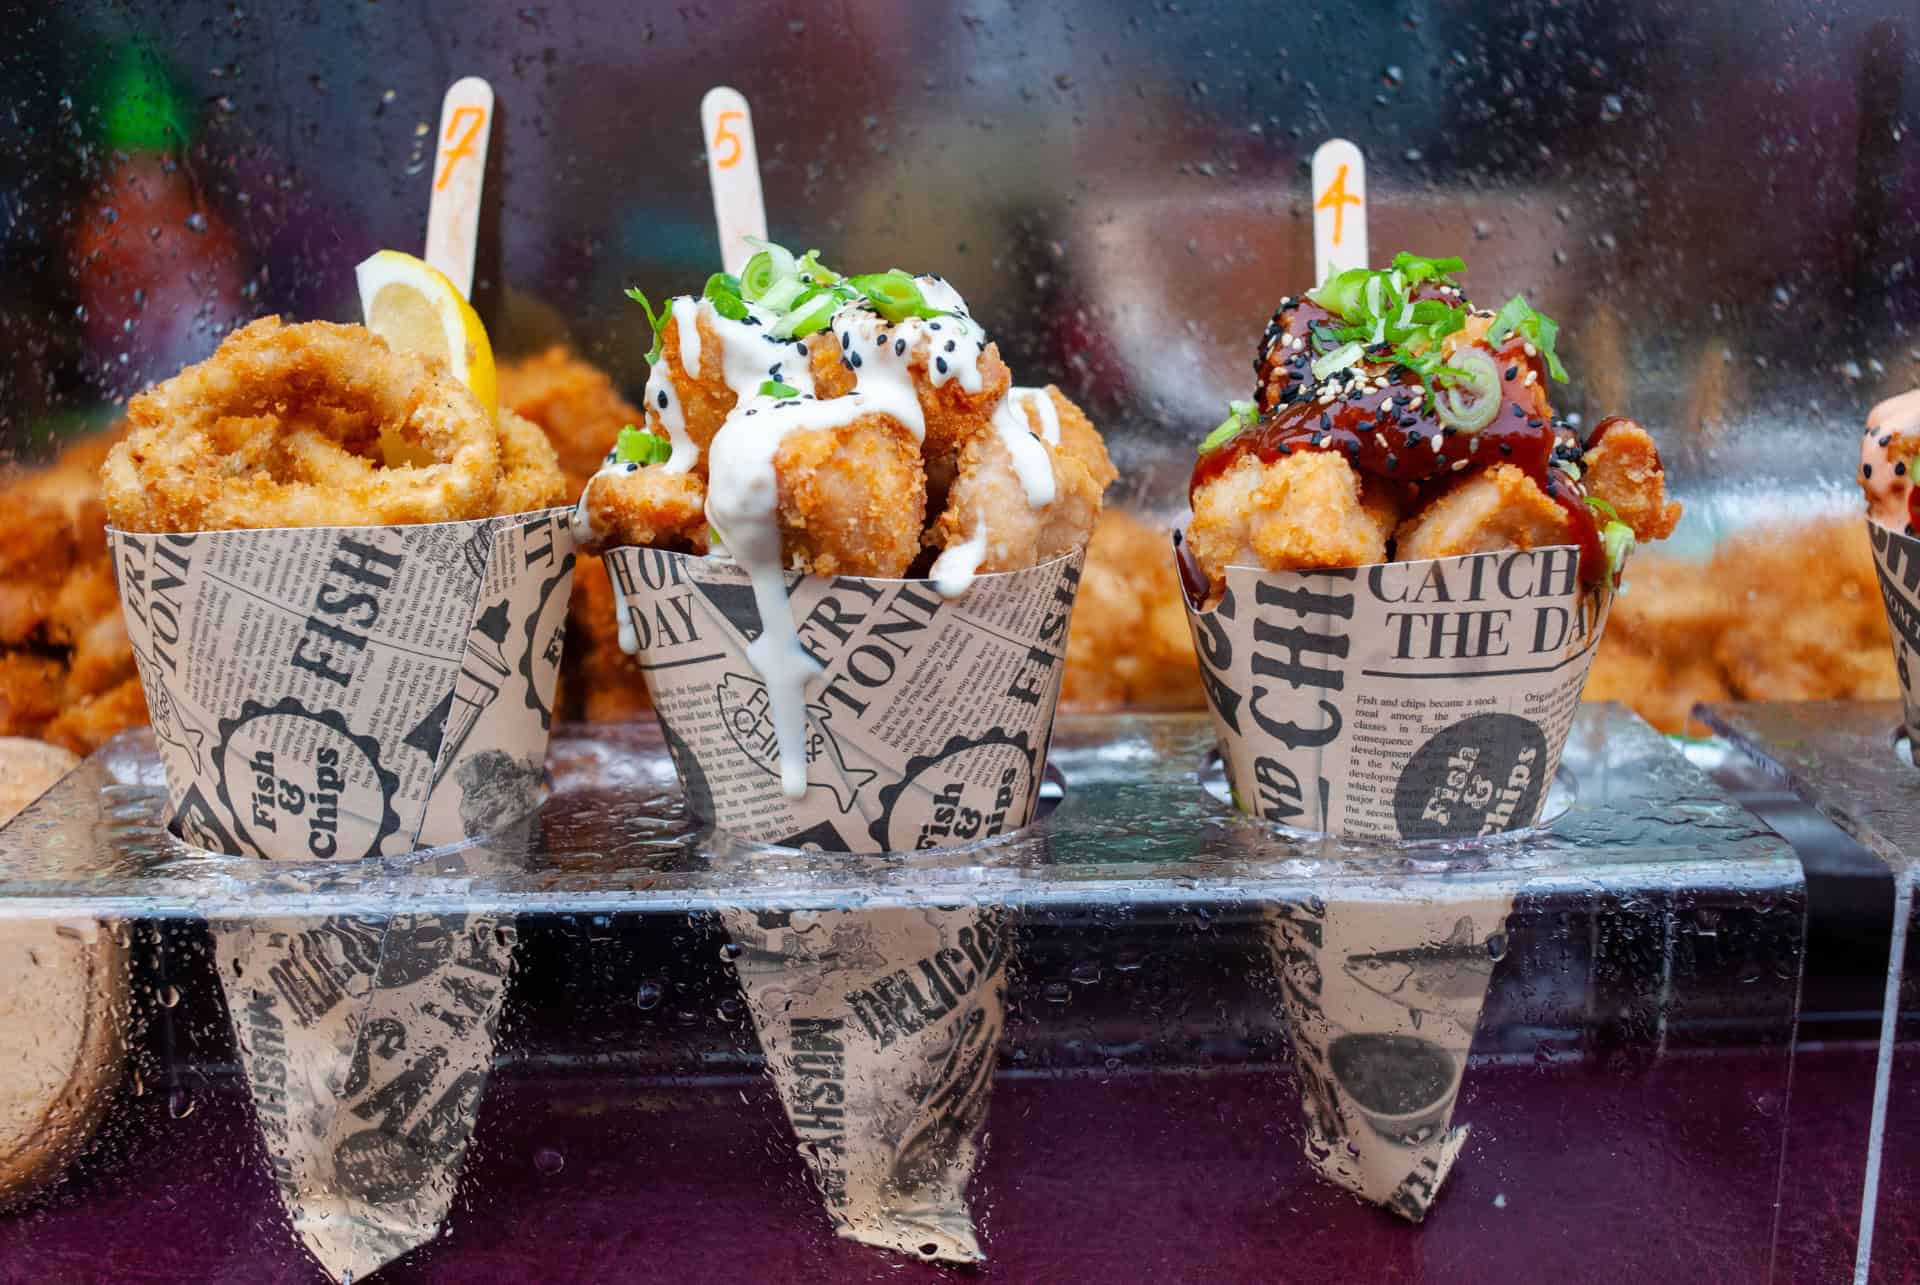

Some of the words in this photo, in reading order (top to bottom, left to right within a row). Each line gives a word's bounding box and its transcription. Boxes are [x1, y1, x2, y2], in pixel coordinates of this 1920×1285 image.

[437, 107, 486, 190] 7
[714, 111, 745, 168] 5
[1315, 163, 1362, 245] 4
[1368, 548, 1580, 603] CATCH
[291, 536, 402, 688] FISH
[628, 593, 702, 650] DAY
[797, 577, 886, 670] FRY
[1385, 609, 1512, 660] THE
[818, 581, 944, 719] TONI
[1250, 568, 1357, 750] CHI
[1353, 720, 1386, 731] classes
[1400, 725, 1408, 733] in
[1356, 709, 1378, 718] meal
[1391, 713, 1424, 723] among
[1434, 711, 1448, 720] the
[1357, 695, 1377, 705] Fish
[1401, 699, 1425, 709] chips
[1430, 699, 1464, 708] became
[1352, 734, 1413, 746] consequence
[1368, 760, 1382, 768] the
[249, 751, 277, 833] Fish
[278, 778, 305, 815] &
[308, 747, 346, 859] Chips
[1255, 757, 1305, 824] ND
[1348, 781, 1376, 792] which
[953, 807, 981, 839] &
